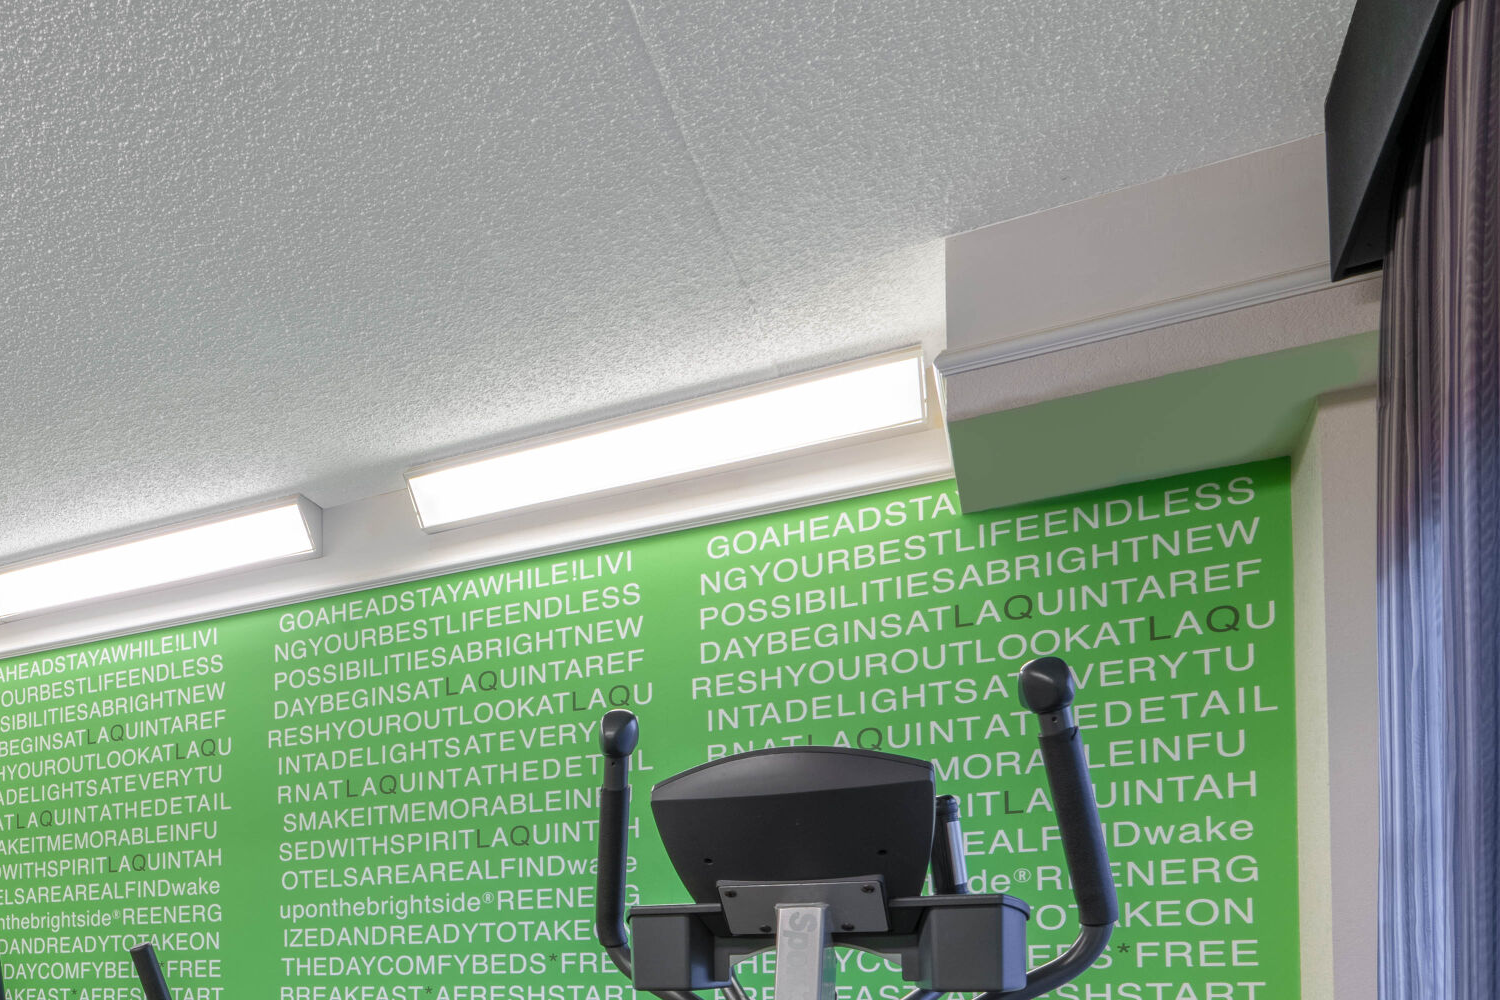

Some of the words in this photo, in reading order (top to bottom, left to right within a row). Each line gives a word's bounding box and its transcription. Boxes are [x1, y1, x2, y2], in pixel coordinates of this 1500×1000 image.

[700, 515, 1261, 632] POSSIBILITIESABRIGHTNEW
[701, 474, 1256, 597] NGYOURBESTLIFEENDLESS
[275, 581, 640, 664] NGYOURBESTLIFEENDLESS
[279, 549, 631, 635] GOAHEADSTAYAWHILE!LIVI
[700, 557, 1262, 666] DAYBEGINSATLAQUINTAREF
[274, 614, 643, 693] POSSIBILITIESABRIGHTNEW
[274, 647, 644, 721] DAYBEGINSATLAQUINTAREF
[692, 597, 1276, 702] RESHYOUROUTLOOKATLAQU
[268, 679, 652, 750] RESHYOUROUTLOOKATLAQU
[279, 715, 638, 777] INTADELIGHTSATEVERY
[278, 747, 653, 806] RNATLAQUINTATHEDETIL
[279, 815, 639, 863] SEDWITHSPIRITLAQUINTH
[282, 849, 637, 891] OTELSAREAREALFINDwae
[282, 950, 619, 977] THEDAYCOMFYBEDSFRE
